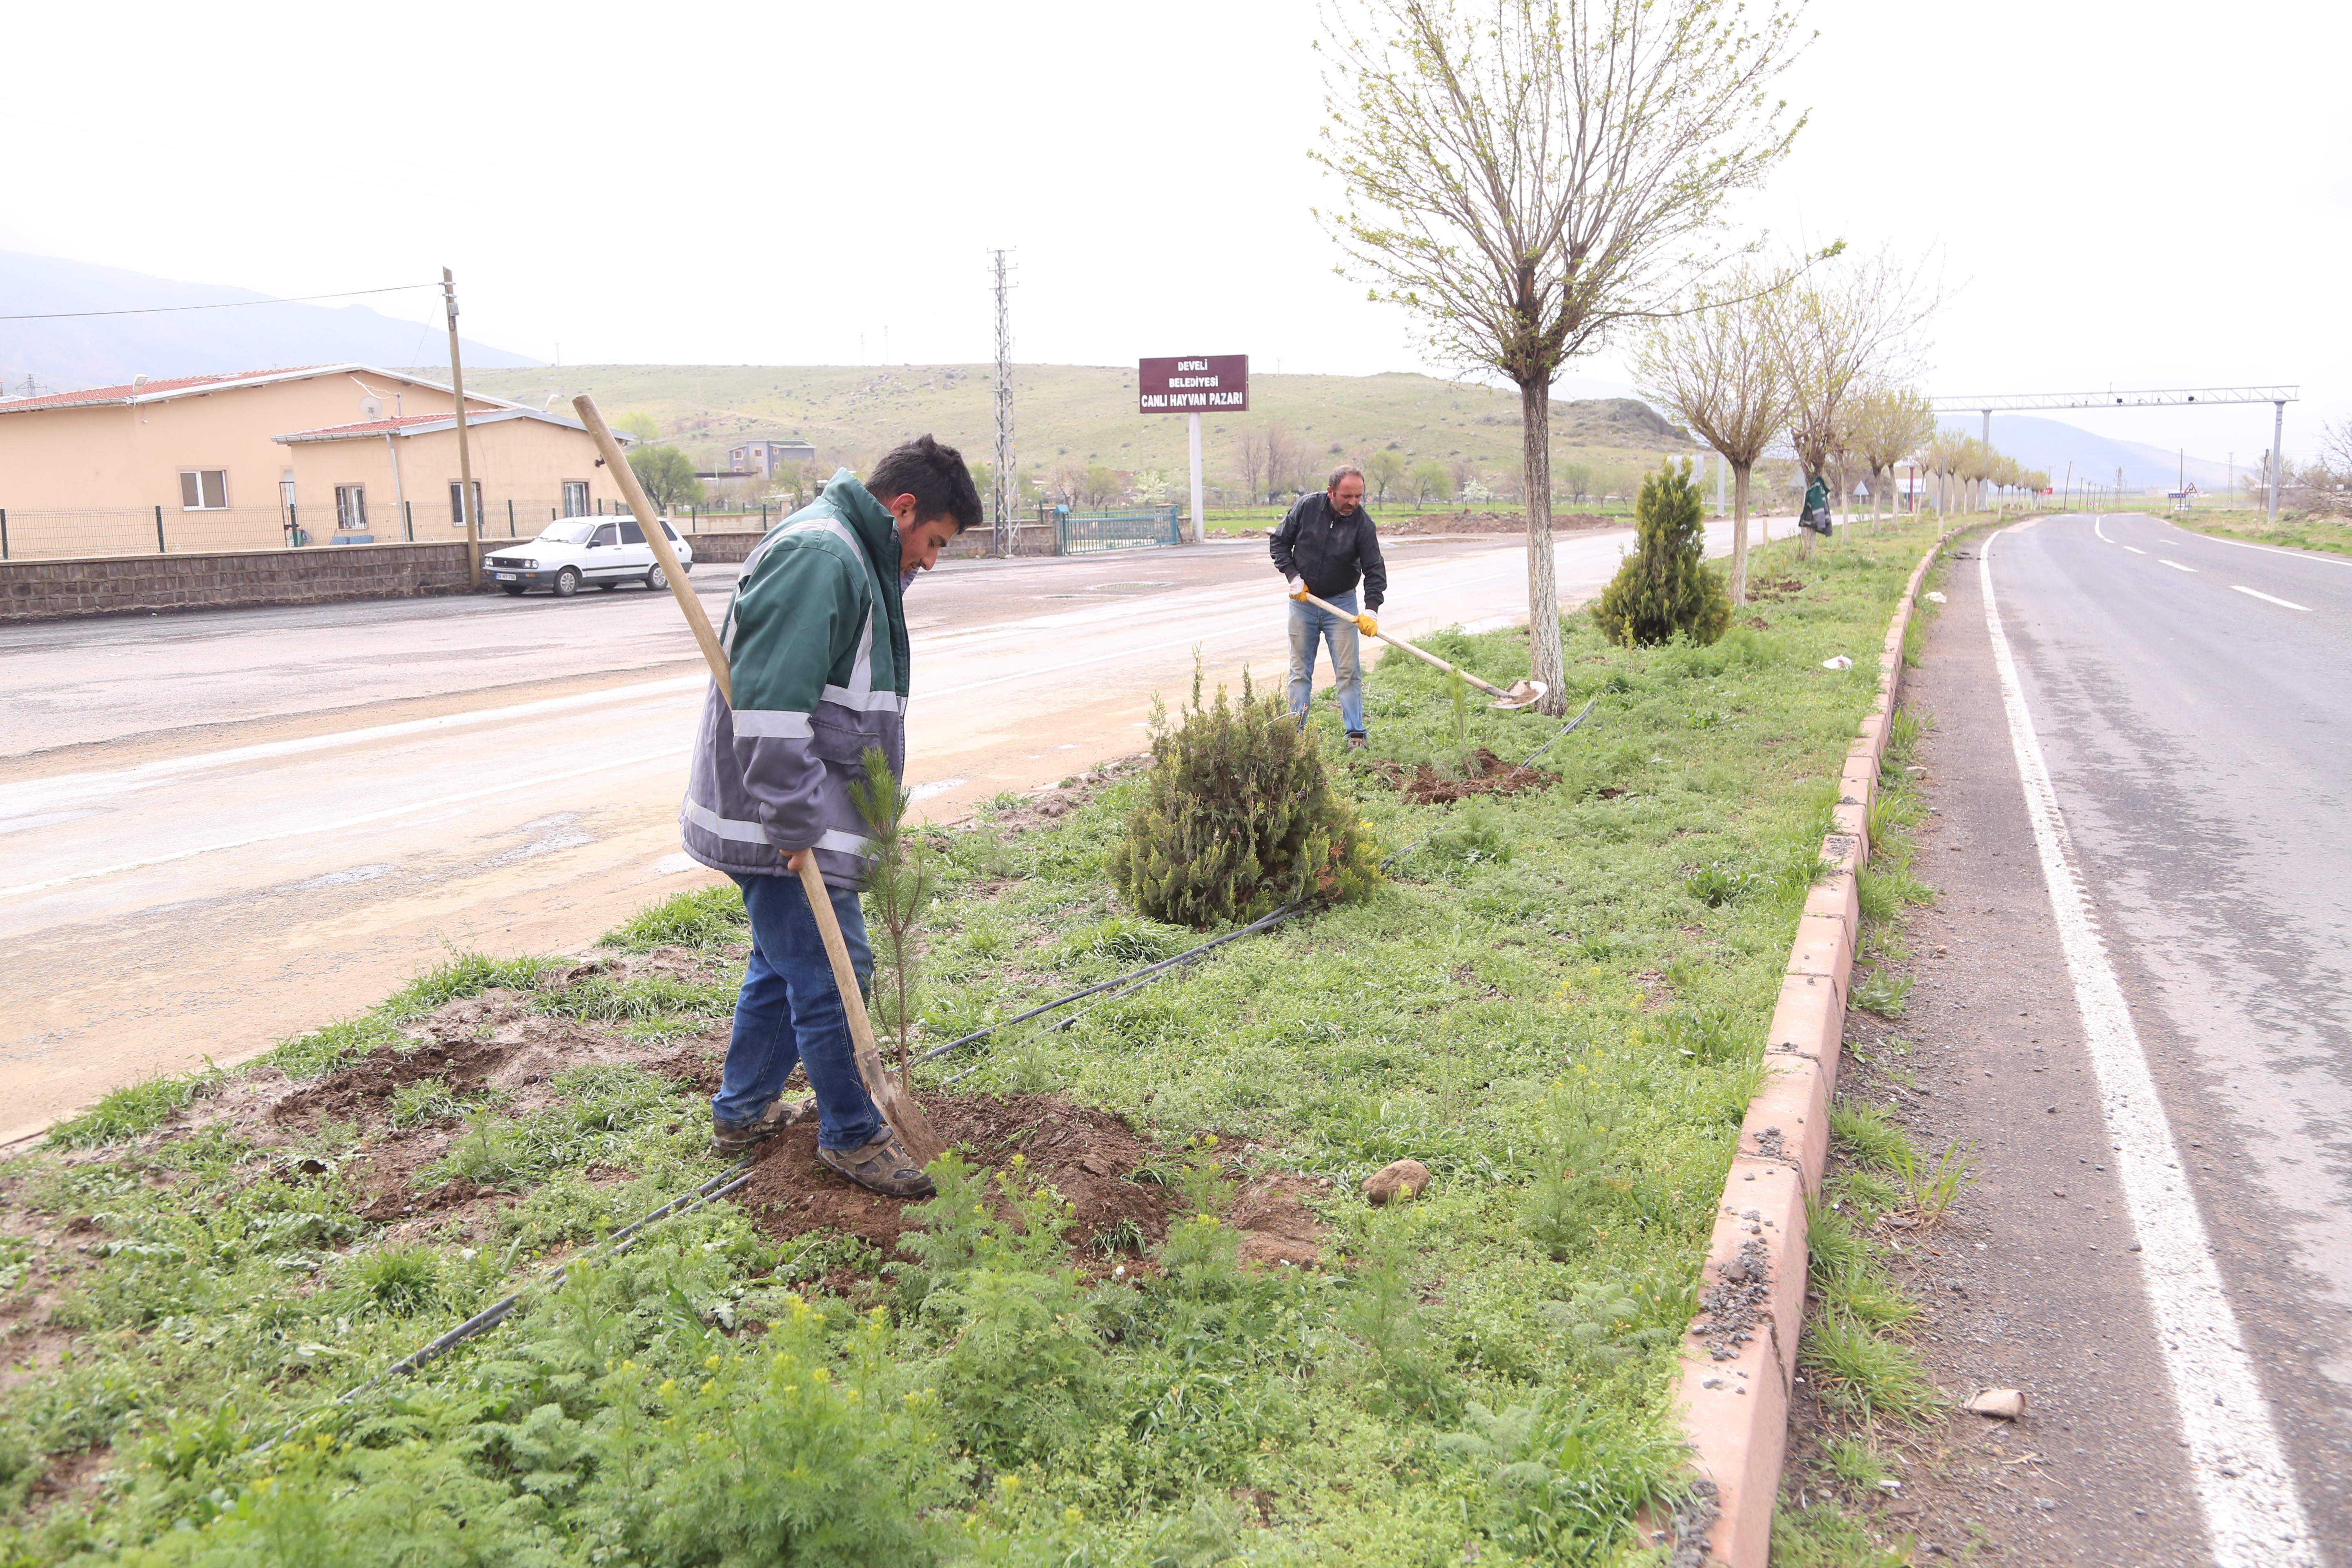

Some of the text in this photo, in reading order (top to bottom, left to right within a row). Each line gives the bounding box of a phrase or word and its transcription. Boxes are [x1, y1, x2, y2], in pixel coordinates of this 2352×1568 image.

[1178, 359, 1208, 371] DEVELİ
[1169, 375, 1218, 388] BELEDİYESİ
[1141, 392, 1243, 408] CANLI HAYVAN PAZARI
